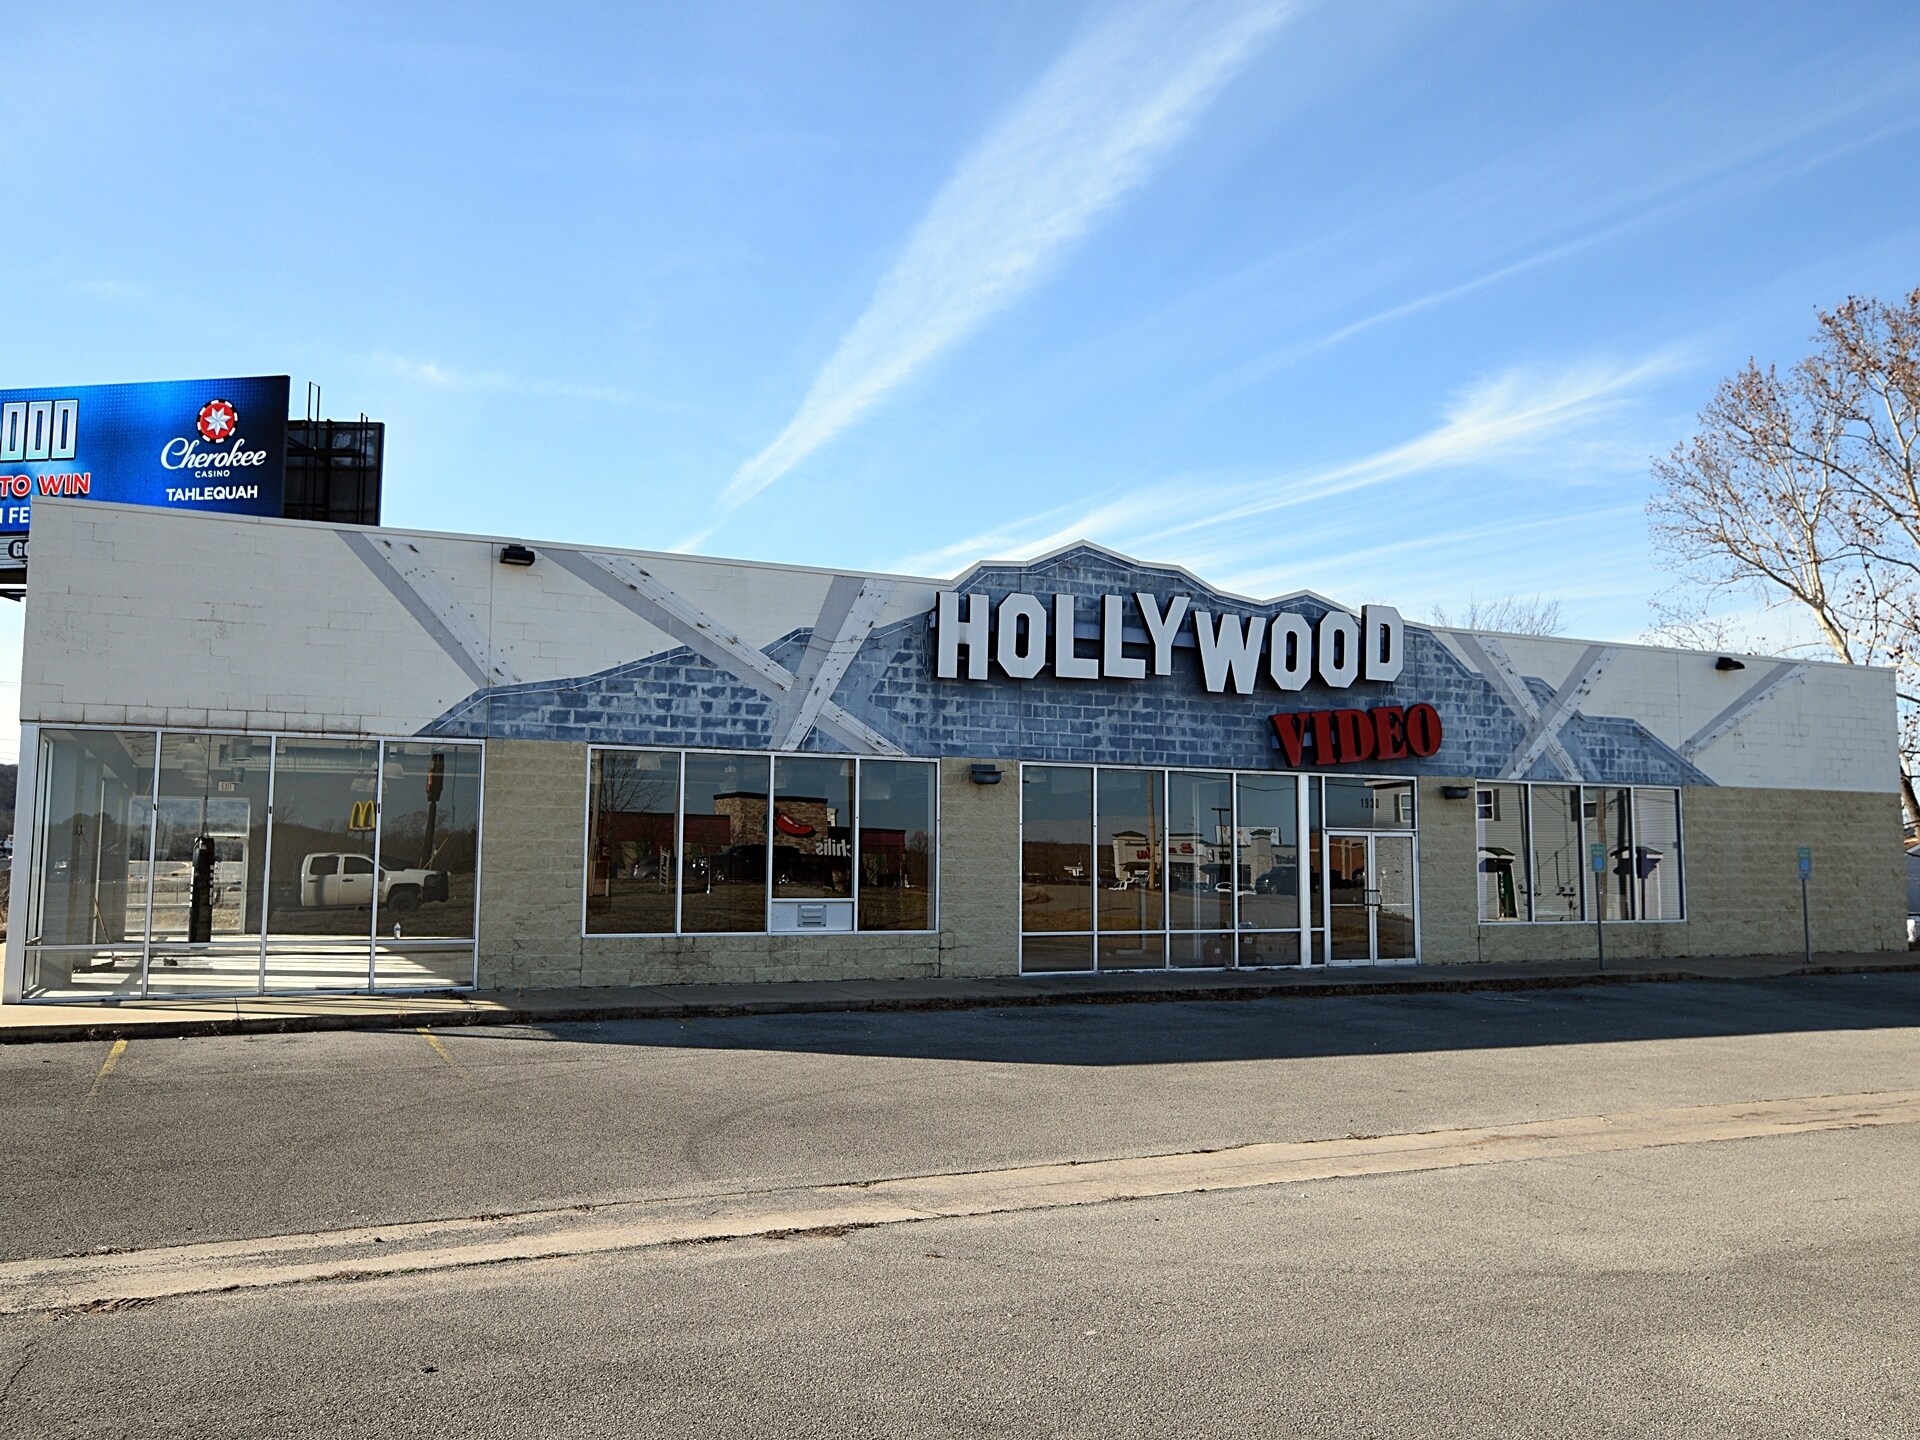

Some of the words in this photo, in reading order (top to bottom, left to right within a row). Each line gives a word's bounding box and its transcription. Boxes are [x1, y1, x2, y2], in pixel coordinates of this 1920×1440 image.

[160, 437, 267, 470] Cherokee
[0, 474, 31, 497] TO
[38, 472, 91, 496] WIN
[195, 469, 231, 478] CASINO
[165, 485, 259, 501] TAHLEQUAH
[935, 591, 1404, 695] HOLLYWOOD
[1270, 703, 1443, 768] VIDEO
